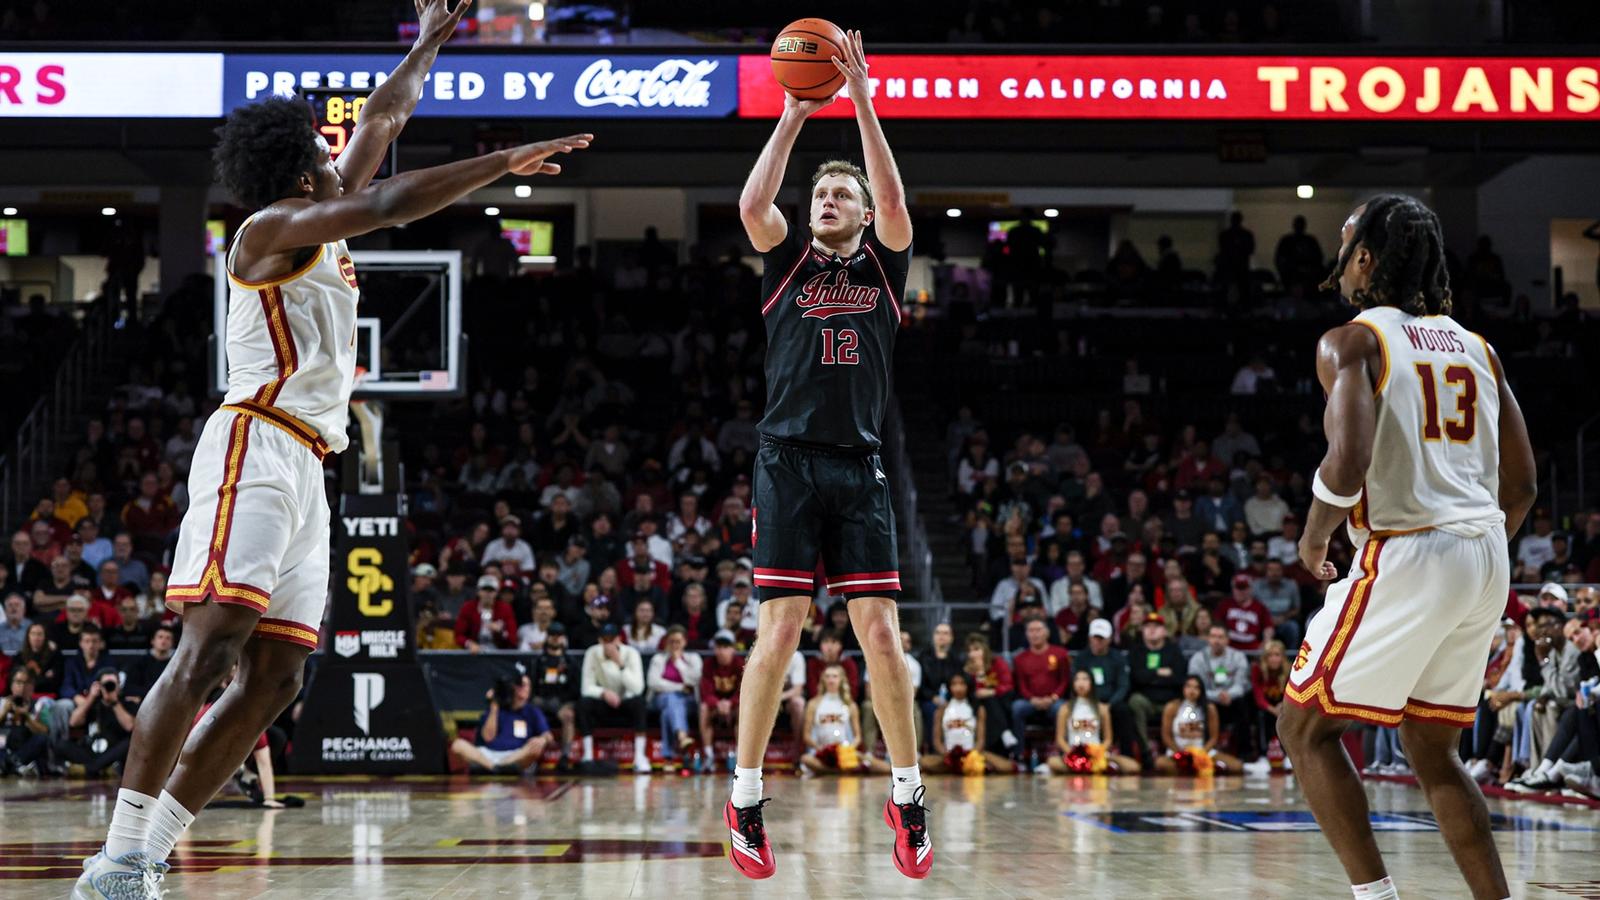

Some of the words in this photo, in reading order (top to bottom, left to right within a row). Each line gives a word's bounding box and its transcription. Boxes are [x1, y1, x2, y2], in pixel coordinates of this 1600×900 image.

[246, 71, 486, 100] PRESEED
[503, 71, 555, 100] BY
[574, 58, 720, 108] Coca-Cola
[1000, 77, 1228, 100] CALIFORNIA
[1257, 65, 1600, 113] TROJANS
[796, 268, 880, 309] Indiana
[821, 328, 860, 365] 12
[1401, 324, 1466, 354] WOODS
[1413, 360, 1479, 444] 13
[342, 517, 399, 537] YETI
[361, 629, 406, 648] MUSCLE
[322, 737, 412, 752] PECHANGA
